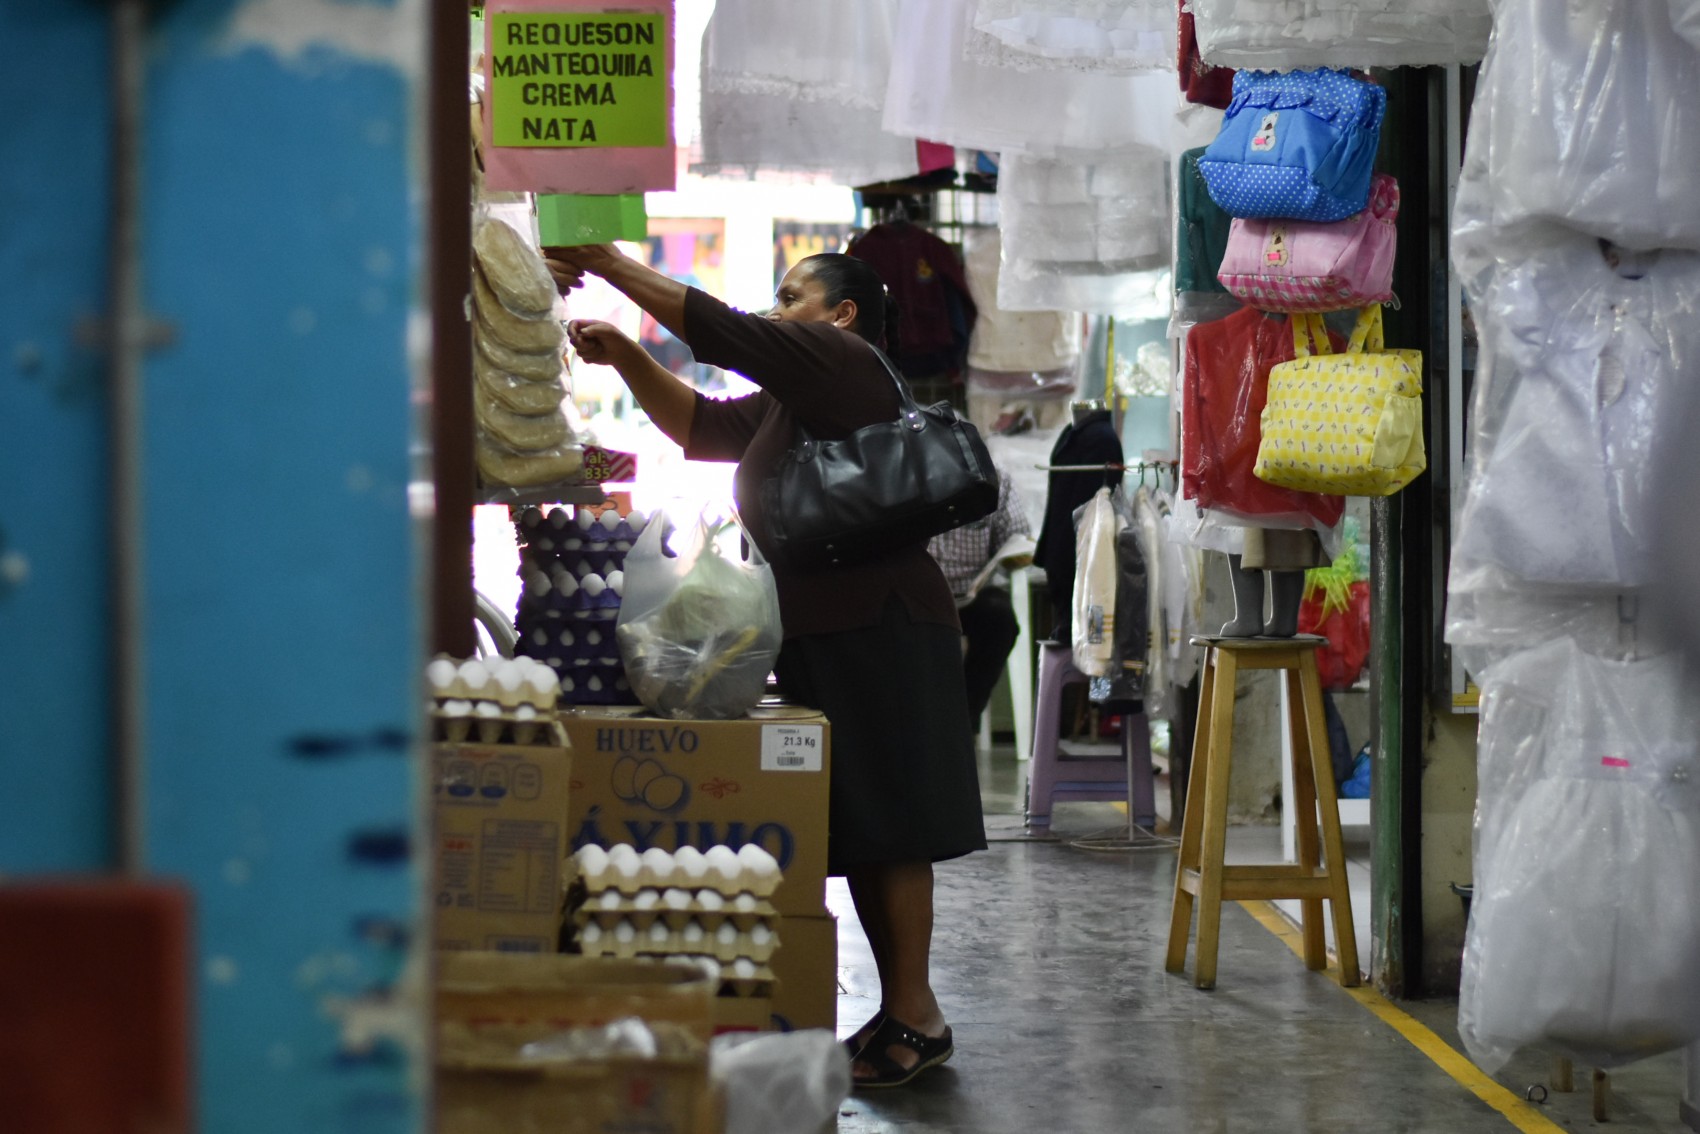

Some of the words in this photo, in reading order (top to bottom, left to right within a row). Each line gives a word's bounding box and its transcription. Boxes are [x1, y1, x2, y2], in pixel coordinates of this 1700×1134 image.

[507, 22, 654, 46] REQUESON
[522, 82, 617, 107] CREMA
[522, 117, 597, 142] NATA
[596, 725, 699, 752] HUEVO
[784, 736, 802, 746] 21.3
[804, 736, 816, 748] Kg
